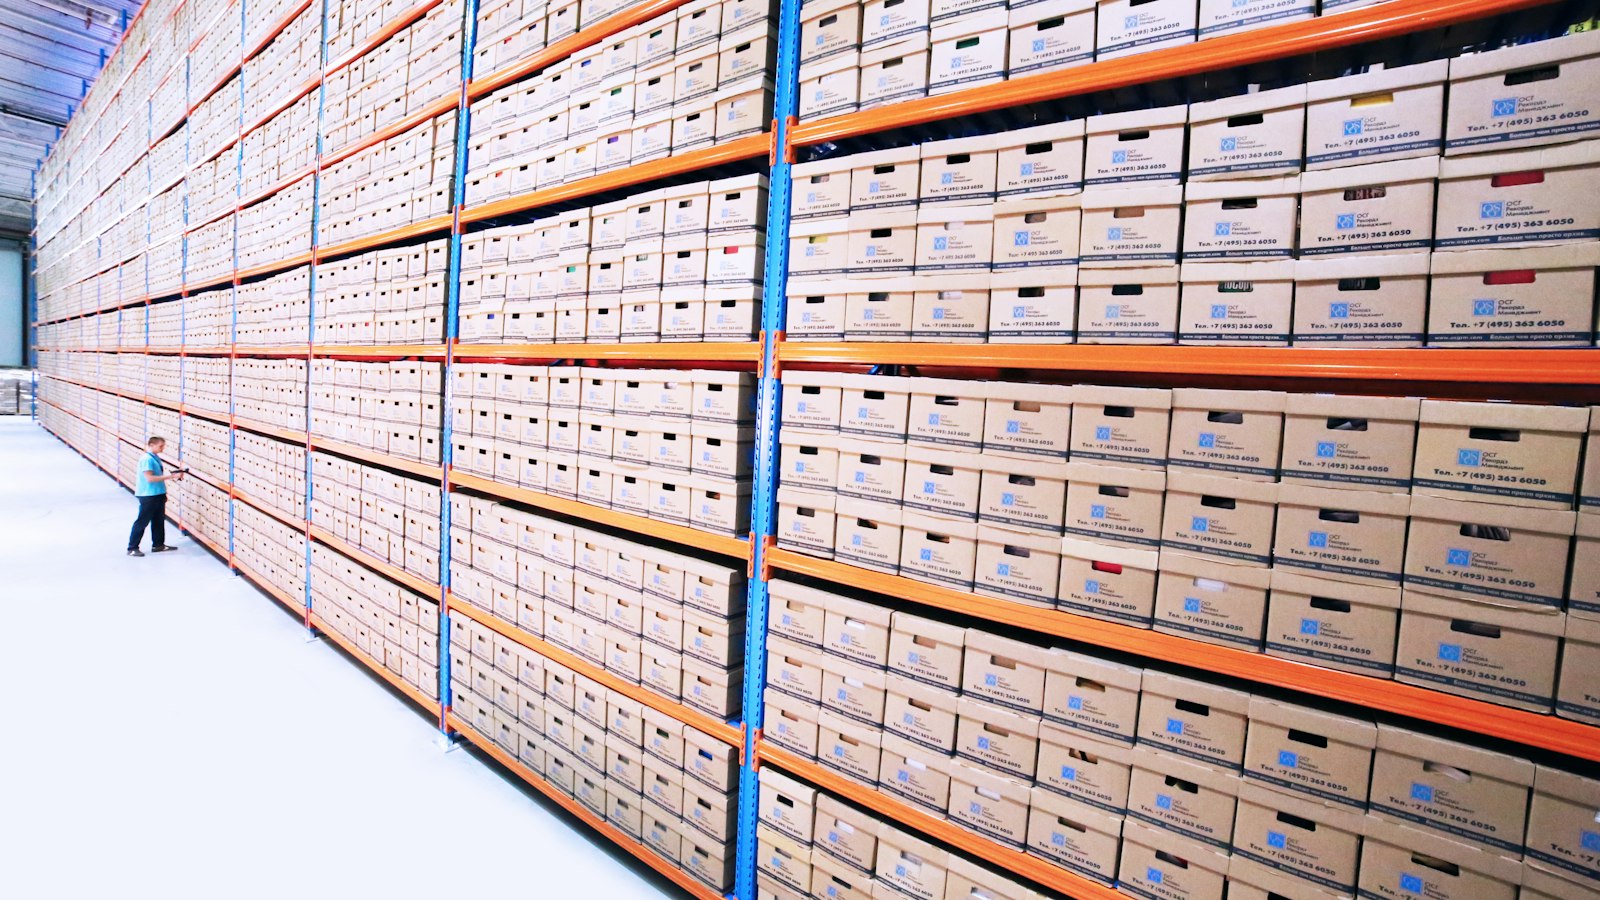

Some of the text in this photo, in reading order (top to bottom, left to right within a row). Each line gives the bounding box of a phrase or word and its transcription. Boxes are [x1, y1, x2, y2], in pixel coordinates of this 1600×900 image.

[1506, 117, 1533, 127] (495)
[1536, 114, 1556, 122] 363
[1559, 110, 1588, 119] 6050
[1397, 130, 1420, 138] 6050
[1495, 222, 1520, 230] (495)
[1470, 472, 1495, 481] (495)
[1519, 477, 1546, 485] 6050
[1358, 557, 1380, 565] 6050
[1460, 571, 1484, 581] (495)
[1487, 576, 1506, 584] 363
[1508, 579, 1535, 588] 6050
[1350, 646, 1371, 655] 6050
[1451, 666, 1475, 677] (495)
[1478, 672, 1496, 681] 363
[1499, 676, 1526, 687] 6050
[1310, 777, 1324, 786] 363
[1326, 782, 1347, 792] 6050
[1449, 814, 1467, 824] 363
[1470, 819, 1496, 832] 6050
[1298, 860, 1313, 869] 363
[1315, 865, 1335, 877] 6050
